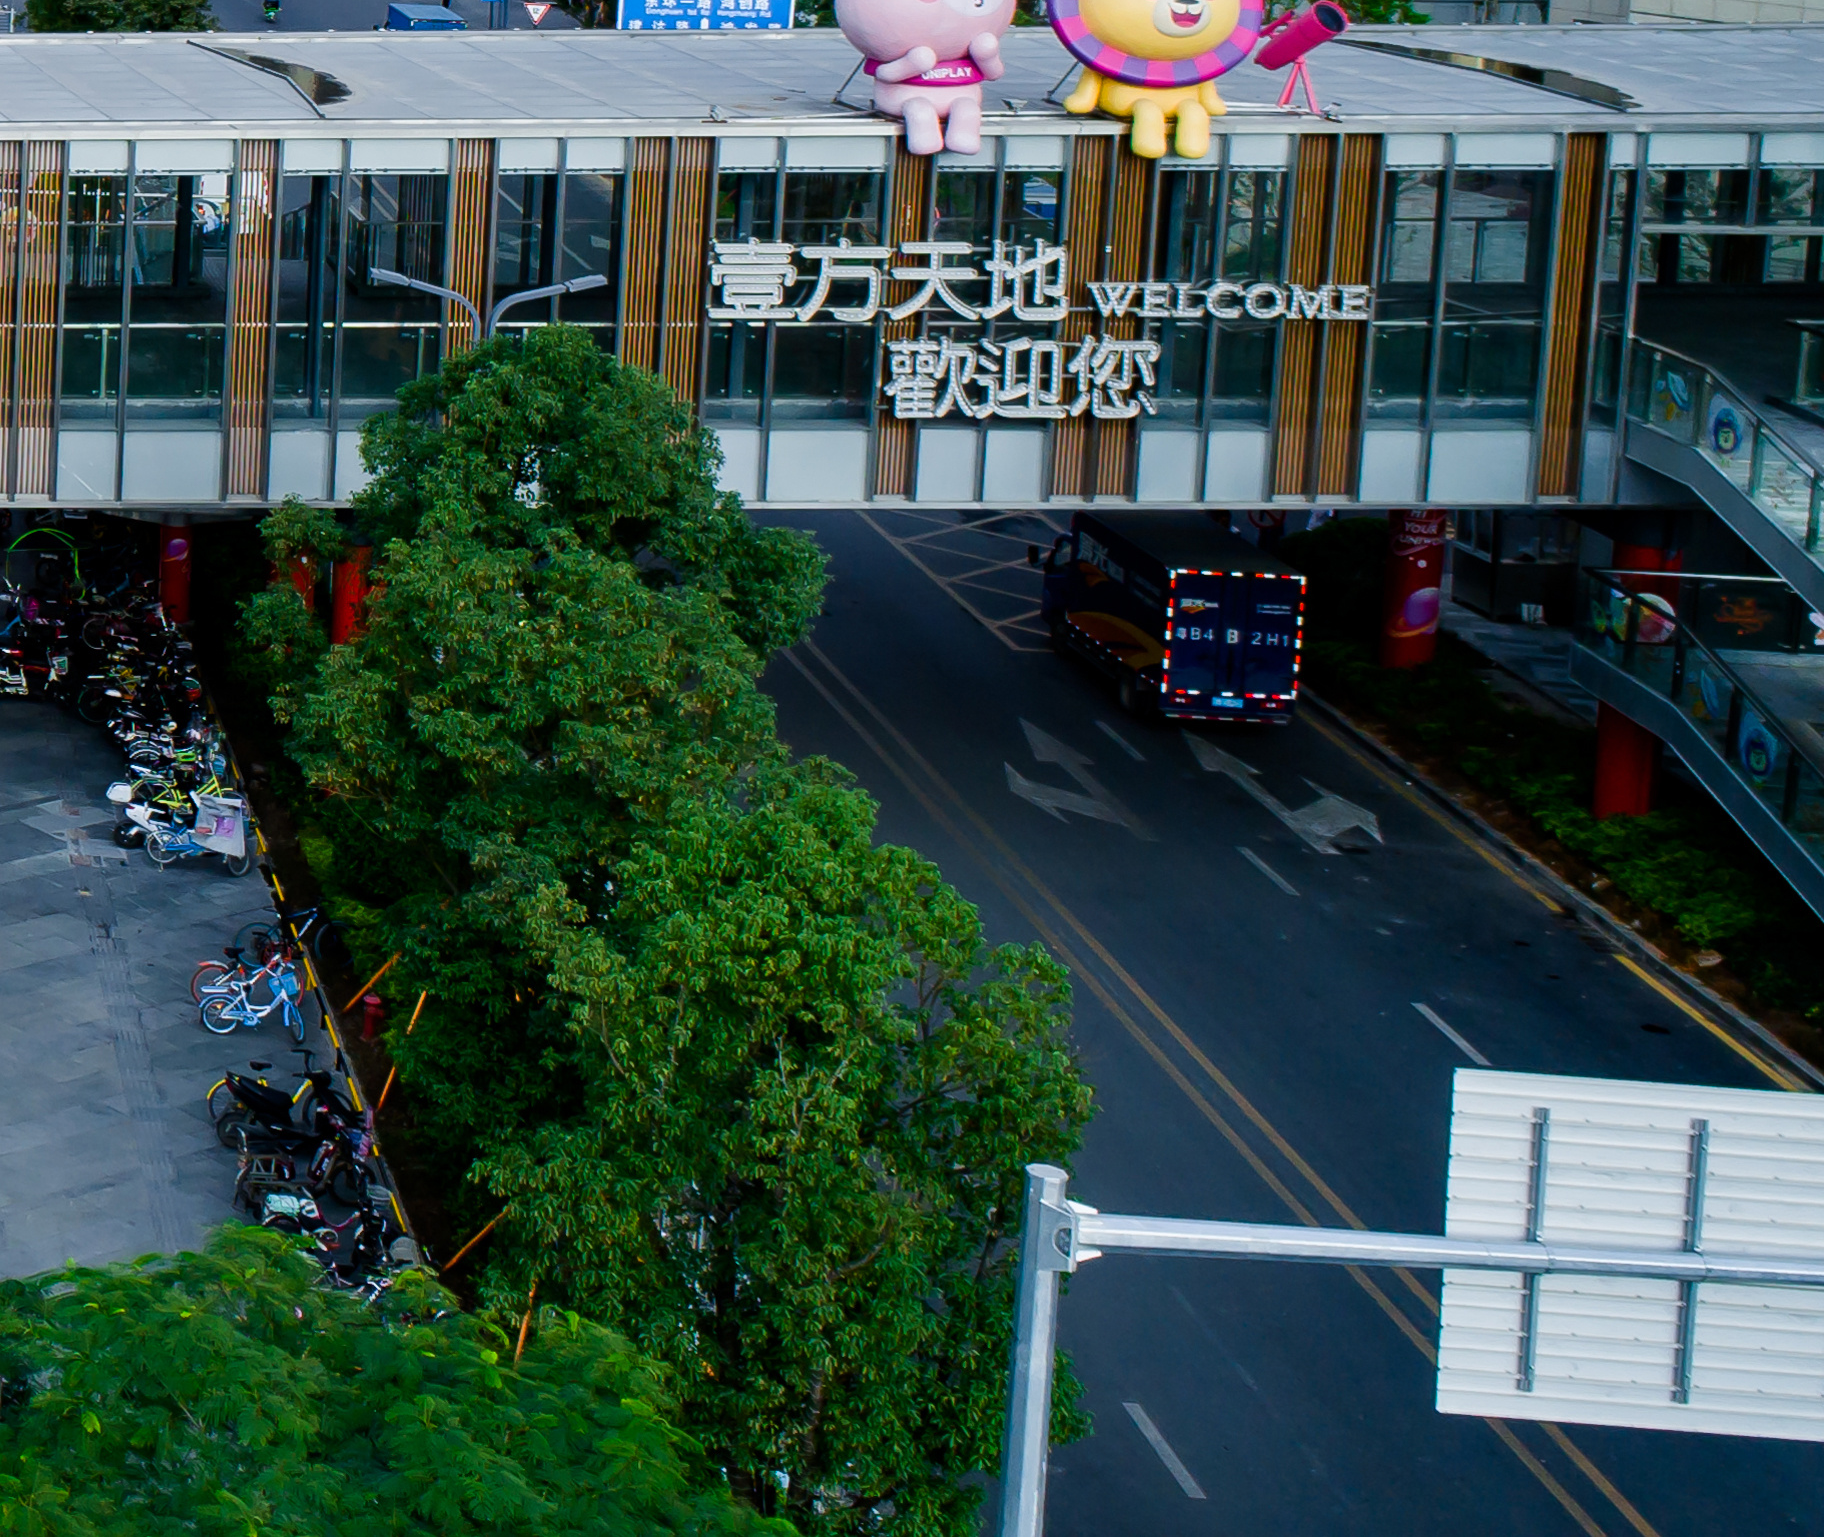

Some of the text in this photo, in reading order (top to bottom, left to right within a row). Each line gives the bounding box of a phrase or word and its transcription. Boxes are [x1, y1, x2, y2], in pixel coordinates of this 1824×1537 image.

[920, 66, 973, 80] UNIPLAY
[707, 237, 1374, 323] 壹方天地 WELCOME
[883, 334, 1163, 420] 歡迎您
[1404, 522, 1438, 535] YOUR
